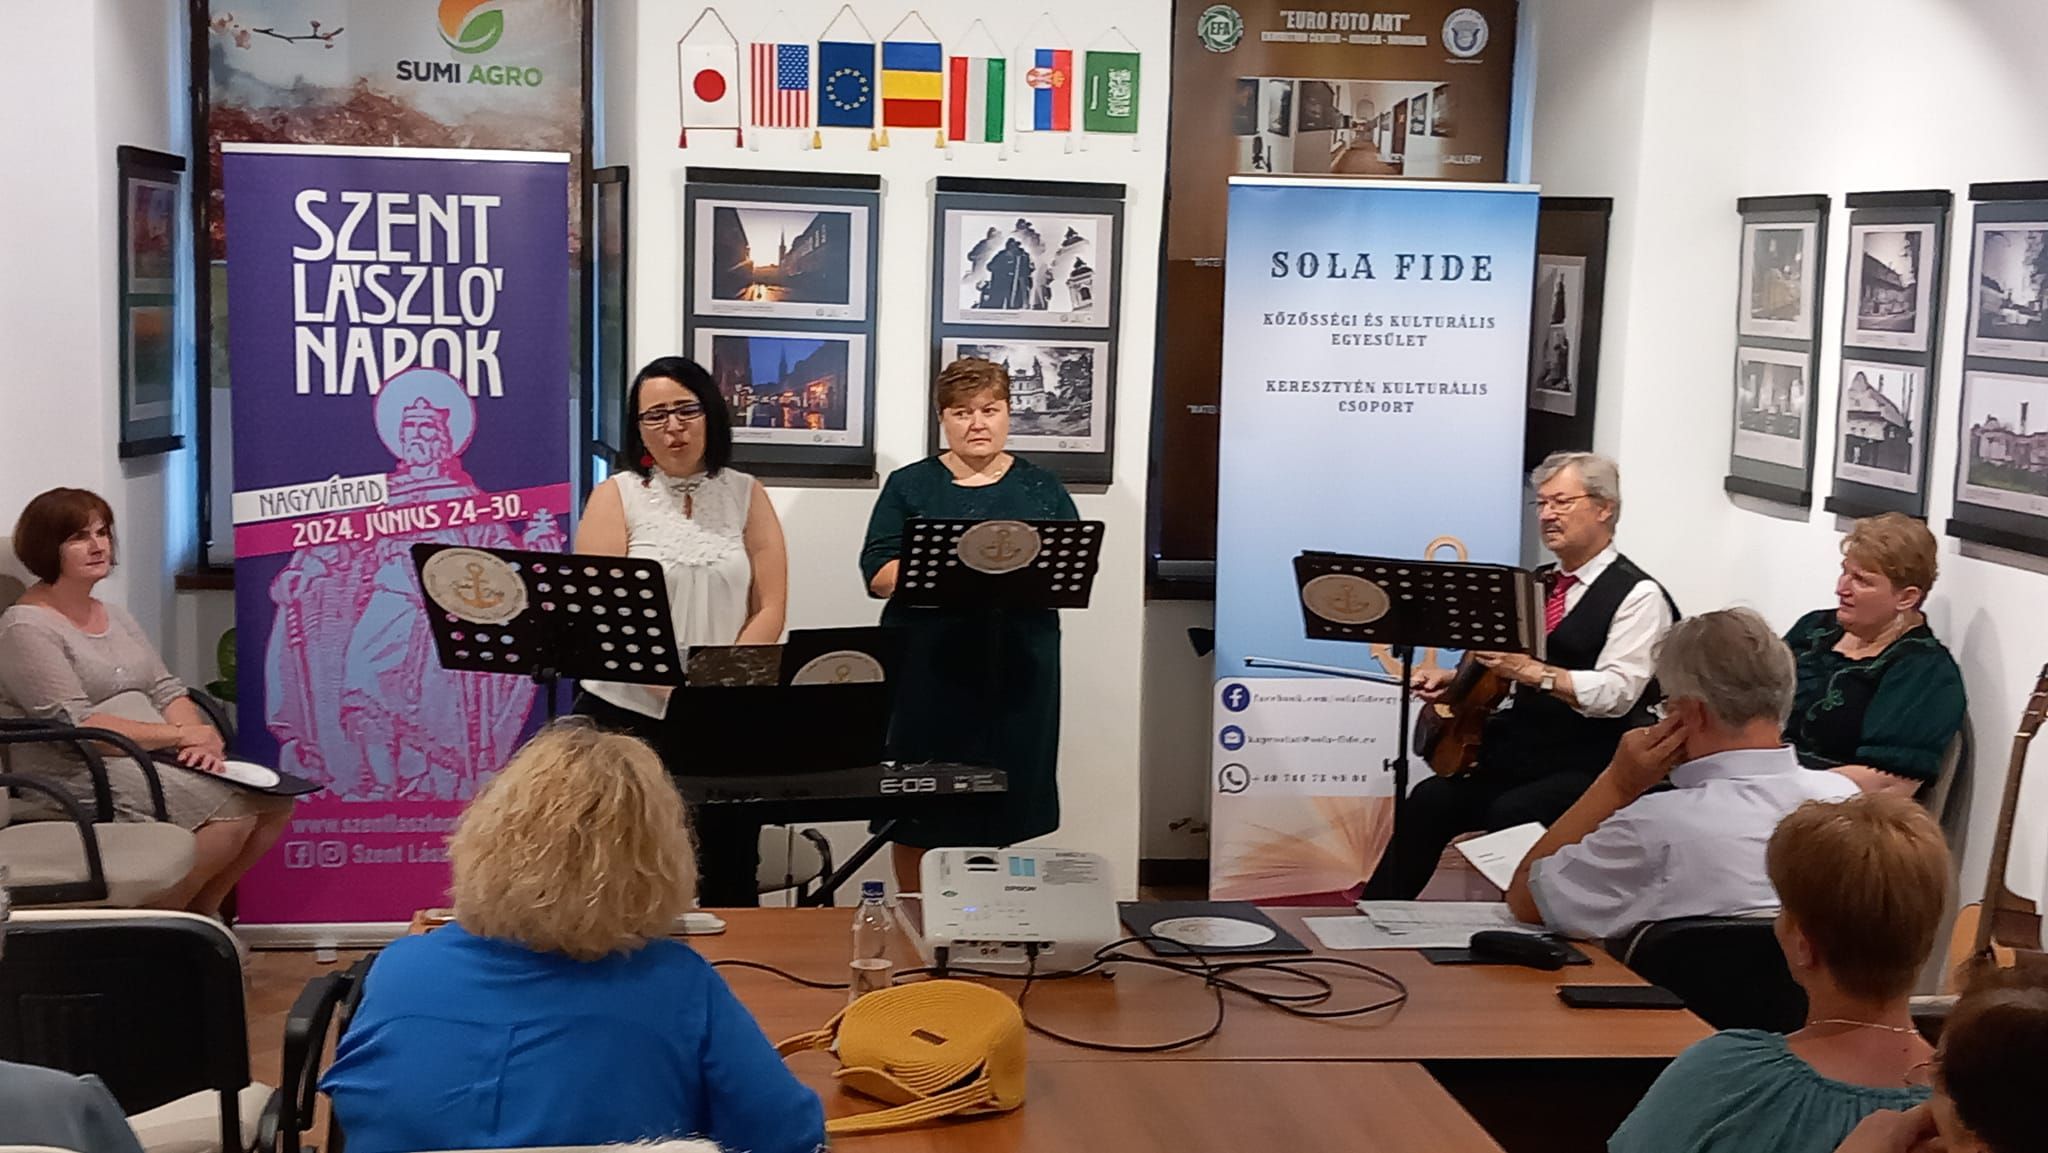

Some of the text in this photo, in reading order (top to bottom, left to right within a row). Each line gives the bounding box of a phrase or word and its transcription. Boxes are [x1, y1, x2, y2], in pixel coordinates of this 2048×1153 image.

[1210, 21, 1231, 36] EFA
[1330, 12, 1370, 31] FOTO
[396, 60, 543, 87] SUMI AGRO
[292, 189, 501, 264] SZENT
[1271, 252, 1492, 282] SOLA FIDE
[292, 263, 504, 327] LÁSZLÓ
[1364, 313, 1384, 327] ÉS
[1390, 313, 1496, 329] KULTURÁLIS
[294, 326, 504, 397] NAPOK
[1266, 379, 1488, 395] KERESZTYÉN KULTURÁLIS
[1338, 400, 1414, 413] CSOPORT
[259, 475, 383, 517] NAGYVÁRAD
[291, 517, 361, 548] 2024.
[363, 504, 441, 541] JÚNIUS
[352, 844, 403, 864] Szent
